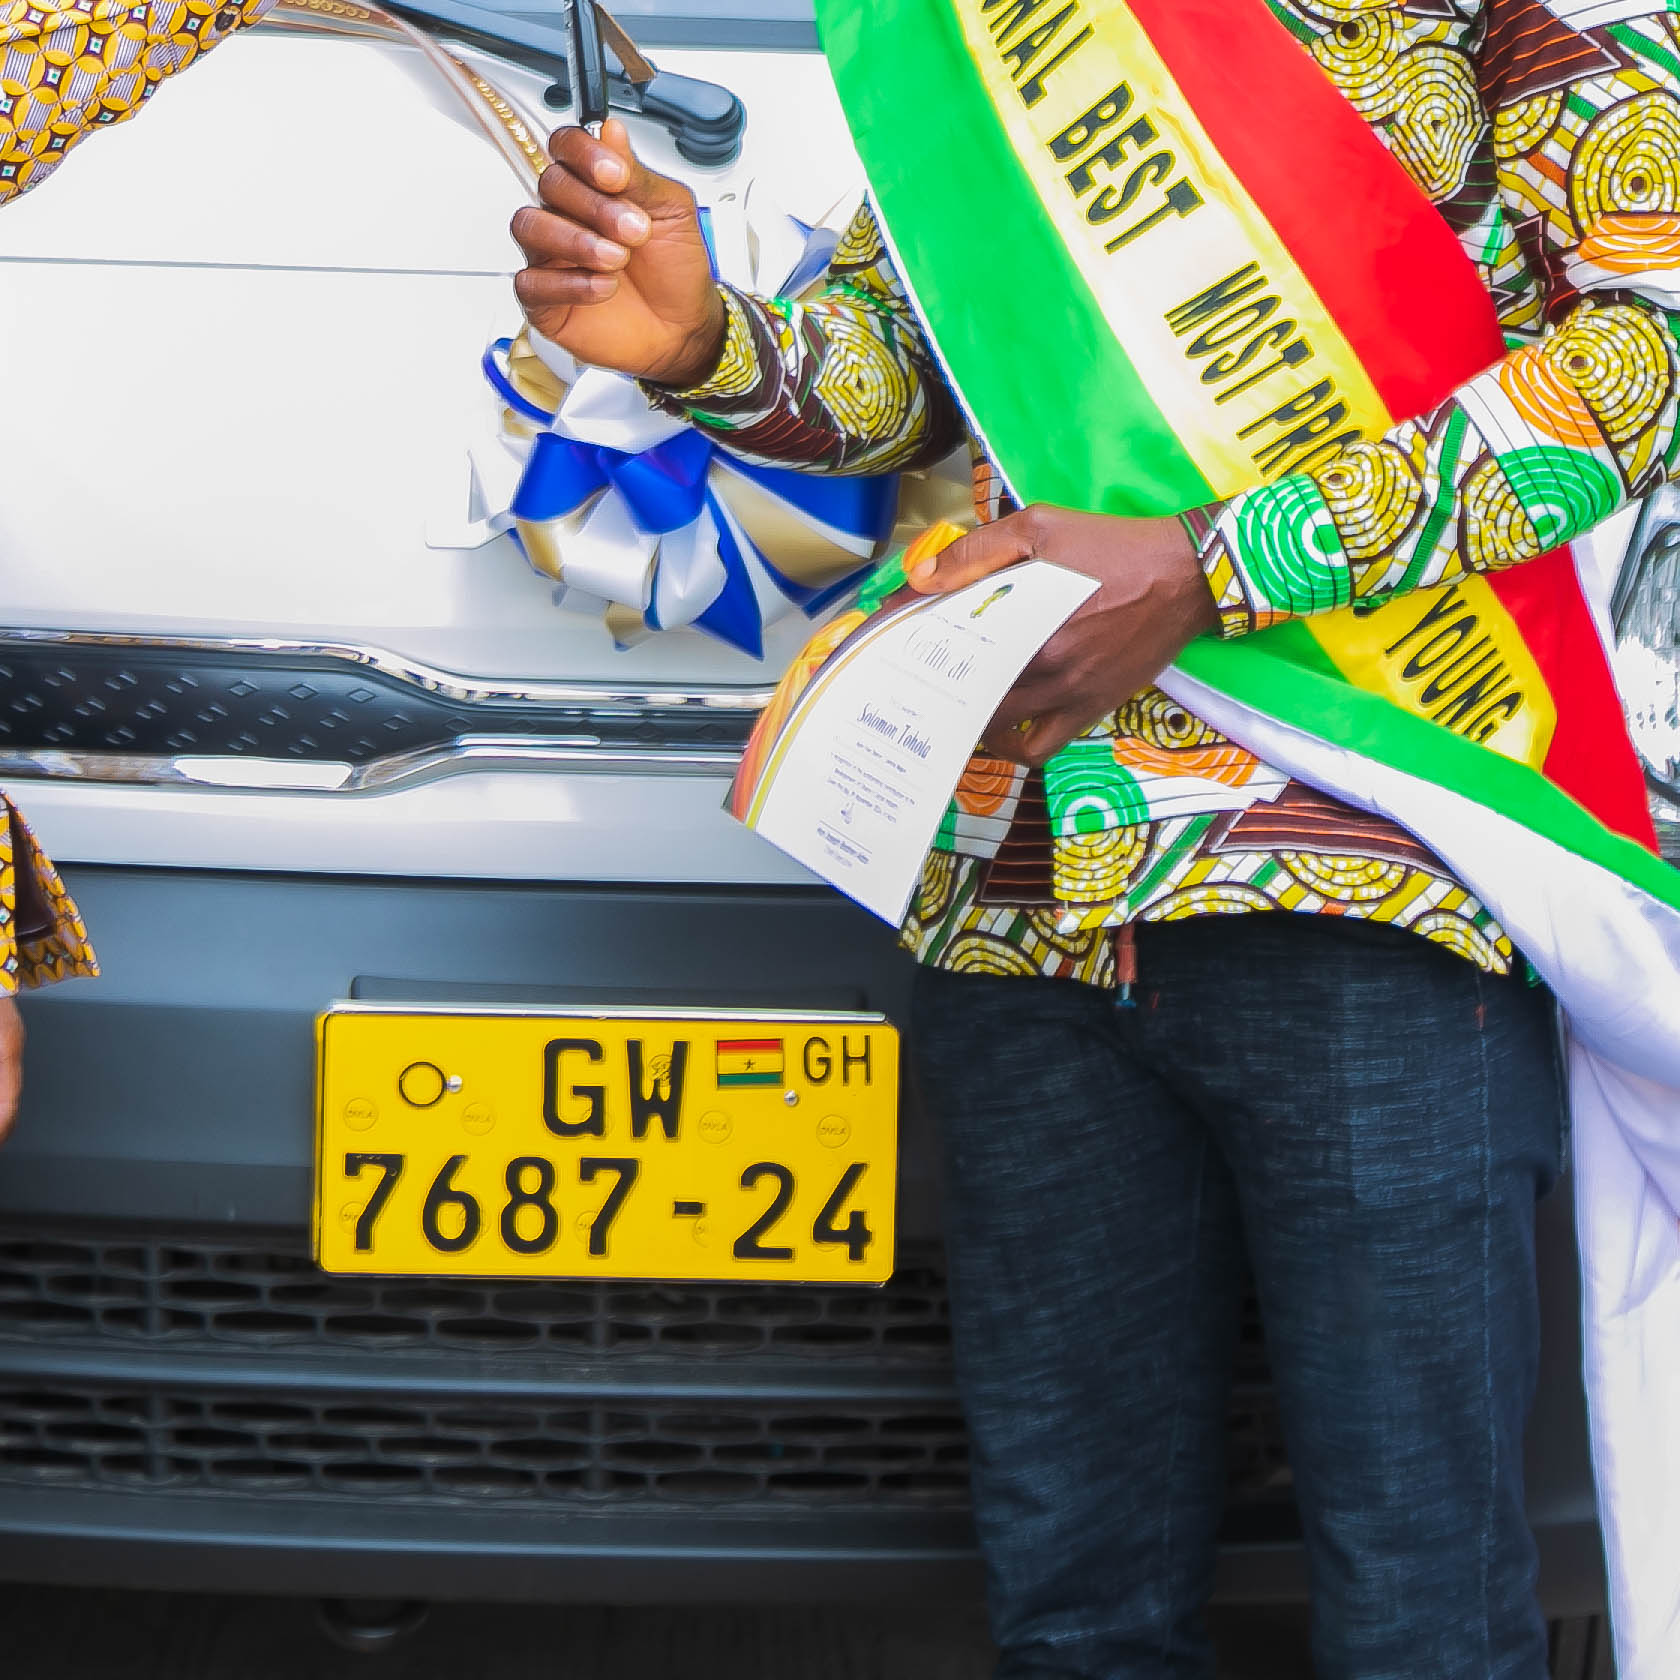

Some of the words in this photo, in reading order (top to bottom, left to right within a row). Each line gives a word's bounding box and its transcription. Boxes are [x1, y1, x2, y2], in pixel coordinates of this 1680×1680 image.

[1047, 80, 1205, 255] BEST
[1163, 261, 1314, 405] MOST
[1384, 584, 1524, 743] YOUNG
[542, 1037, 691, 1141] GW
[803, 1035, 873, 1086] GH
